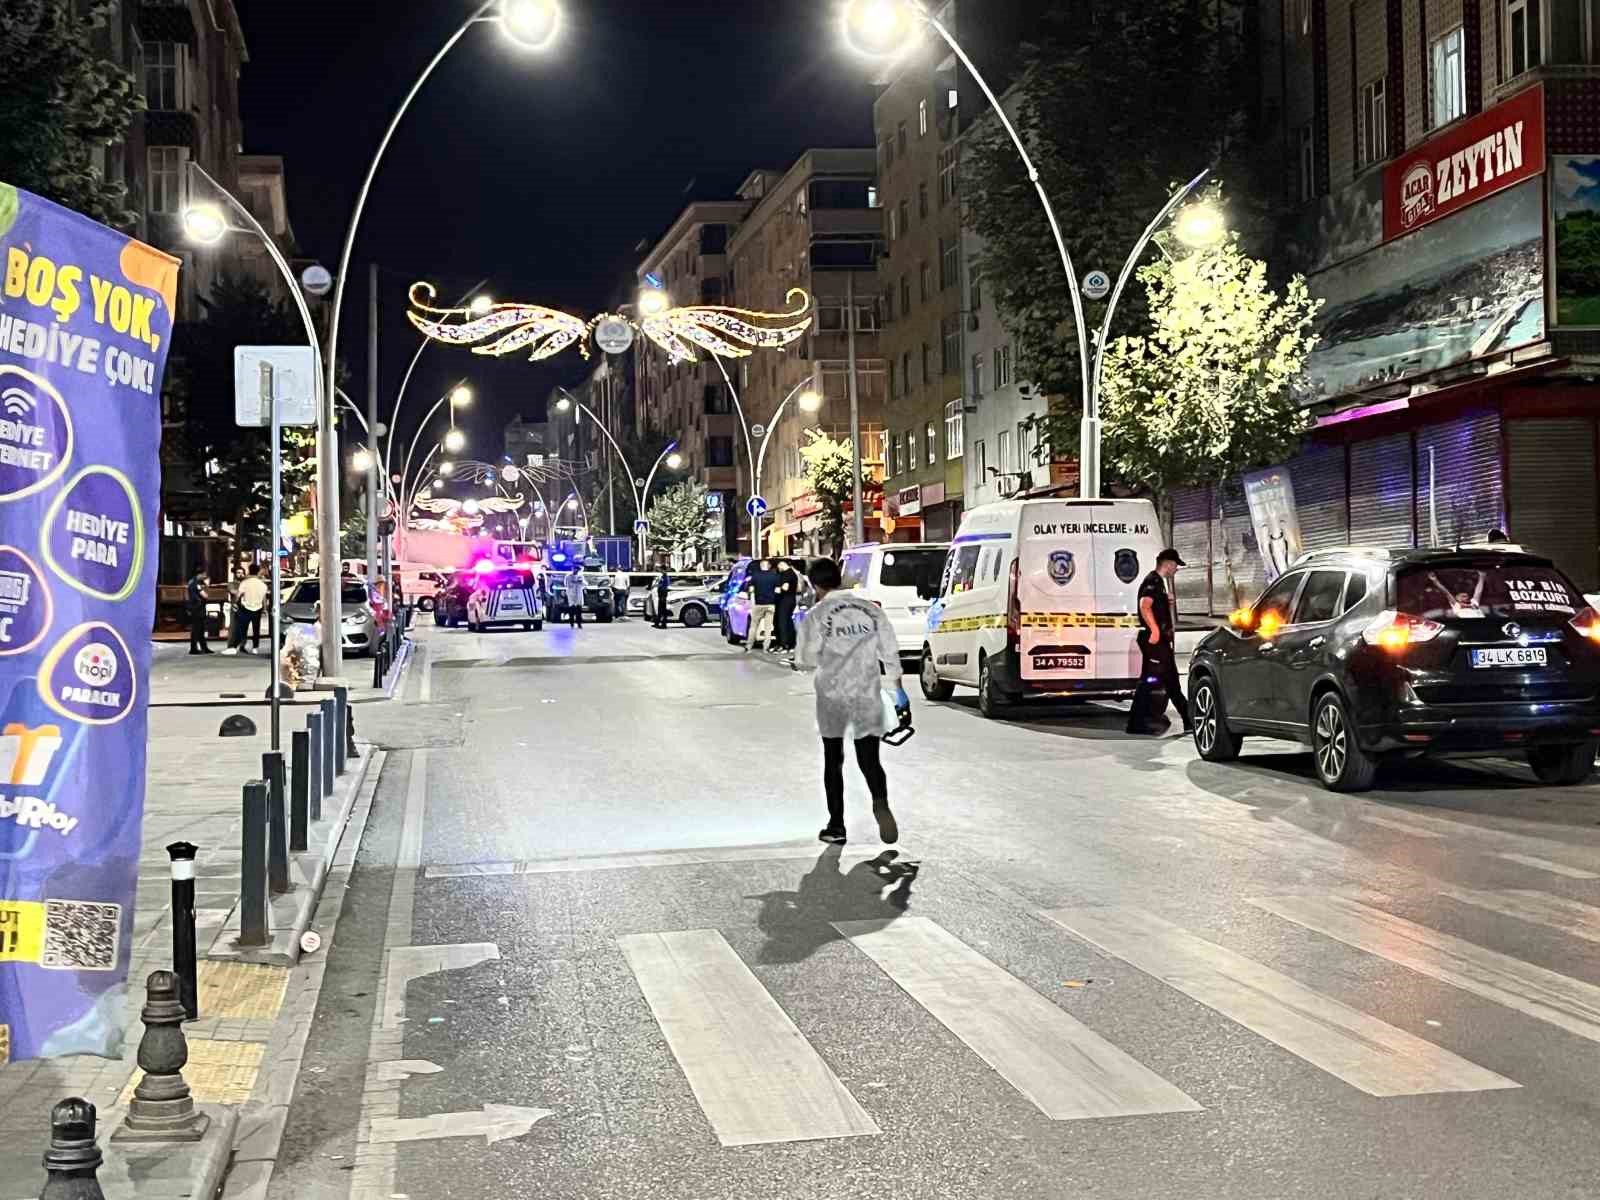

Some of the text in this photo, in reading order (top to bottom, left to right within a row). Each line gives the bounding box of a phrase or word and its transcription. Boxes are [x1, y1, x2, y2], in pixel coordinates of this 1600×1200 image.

[1437, 120, 1523, 205] ZEYTİN
[5, 247, 160, 352] BOŞ YOK,
[0, 313, 154, 394] HEDİYE ÇOK!
[66, 509, 129, 544] HEDİYE
[1033, 524, 1057, 535] OLAY
[71, 537, 118, 568] PARA
[1504, 580, 1535, 590] YAP
[1509, 590, 1570, 605] BOZKURT
[1035, 658, 1046, 667] 34
[1048, 658, 1055, 667] A
[1479, 649, 1545, 663] 34 LK 6819
